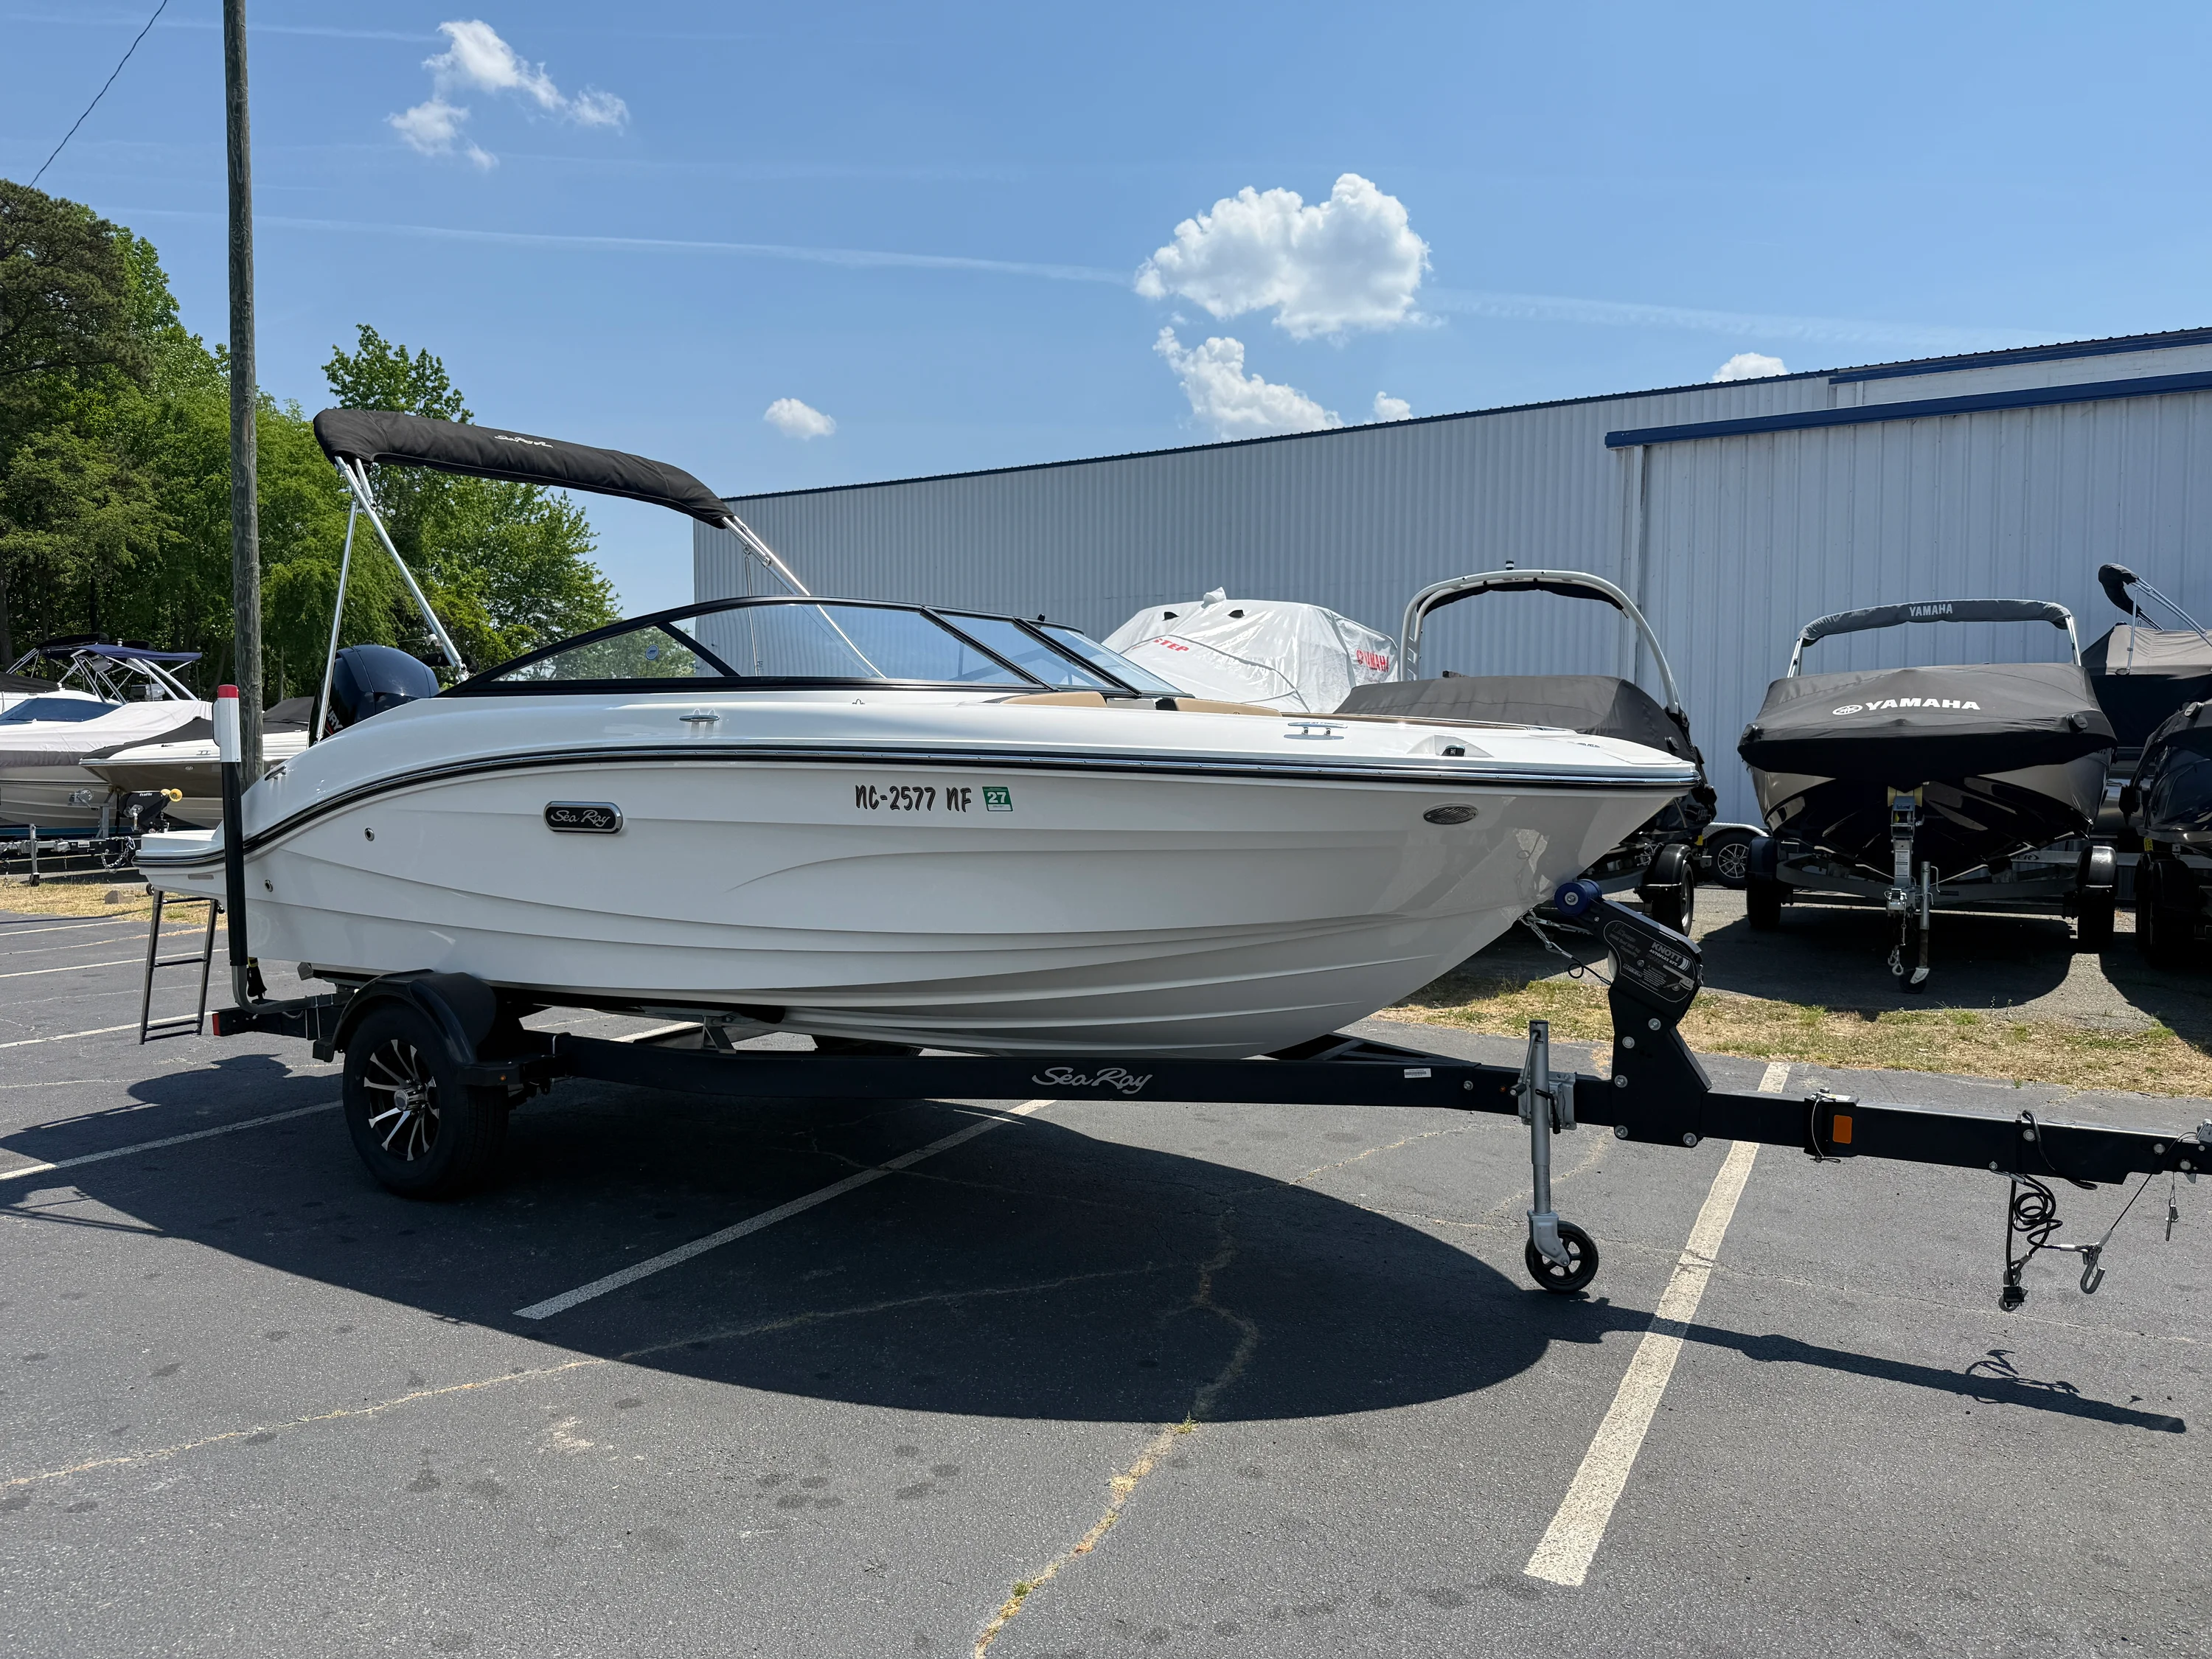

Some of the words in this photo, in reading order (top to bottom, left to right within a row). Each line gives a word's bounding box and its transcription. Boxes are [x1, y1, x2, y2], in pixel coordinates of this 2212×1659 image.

[1909, 604, 1953, 616] YAMAHA
[1865, 698, 1980, 711] YAMAHA
[855, 785, 936, 811] NC-2577
[946, 787, 972, 812] NF
[987, 791, 1006, 804] 27
[551, 810, 580, 823] Sea
[581, 810, 611, 827] Ray
[1652, 942, 1683, 961] KNOTT
[1032, 1066, 1094, 1086] Sea
[1091, 1067, 1153, 1095] Ray
